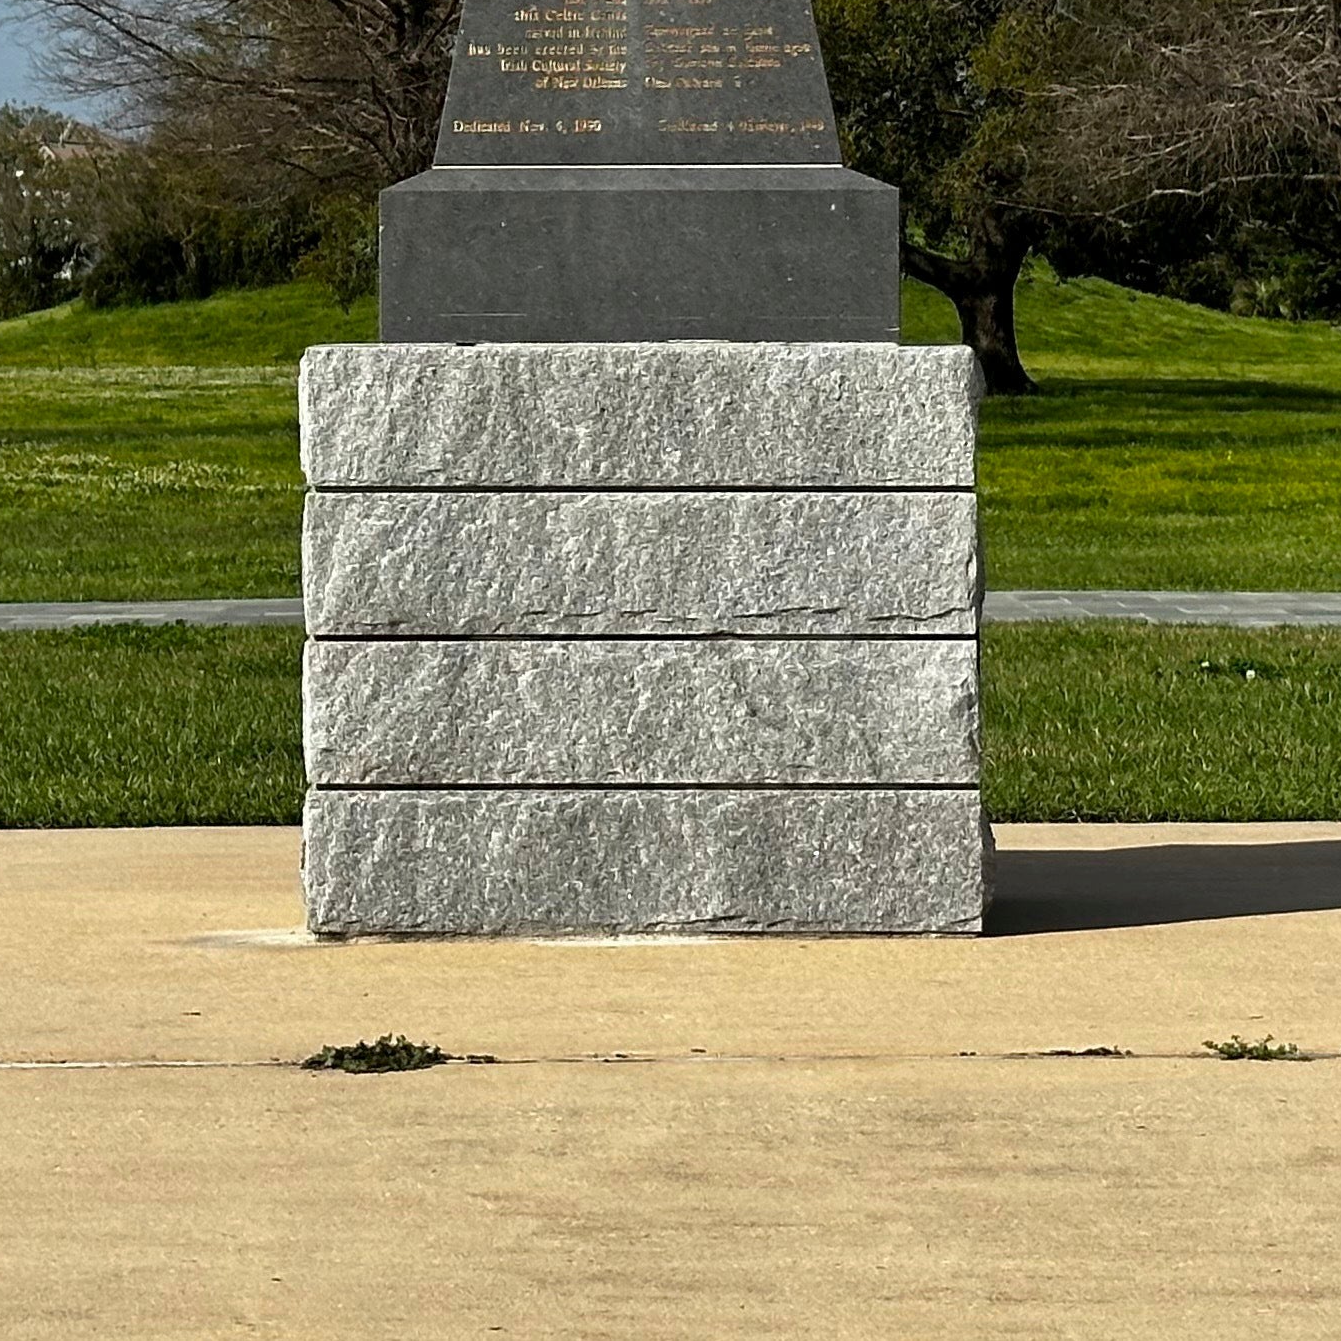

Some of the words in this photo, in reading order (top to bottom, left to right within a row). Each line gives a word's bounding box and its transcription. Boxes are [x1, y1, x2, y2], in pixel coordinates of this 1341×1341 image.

[545, 9, 584, 21] Celtic
[468, 43, 491, 56] has
[497, 43, 527, 55] been
[535, 43, 584, 56] erected
[532, 59, 580, 73] Cultural
[453, 119, 510, 133] Dedicated
